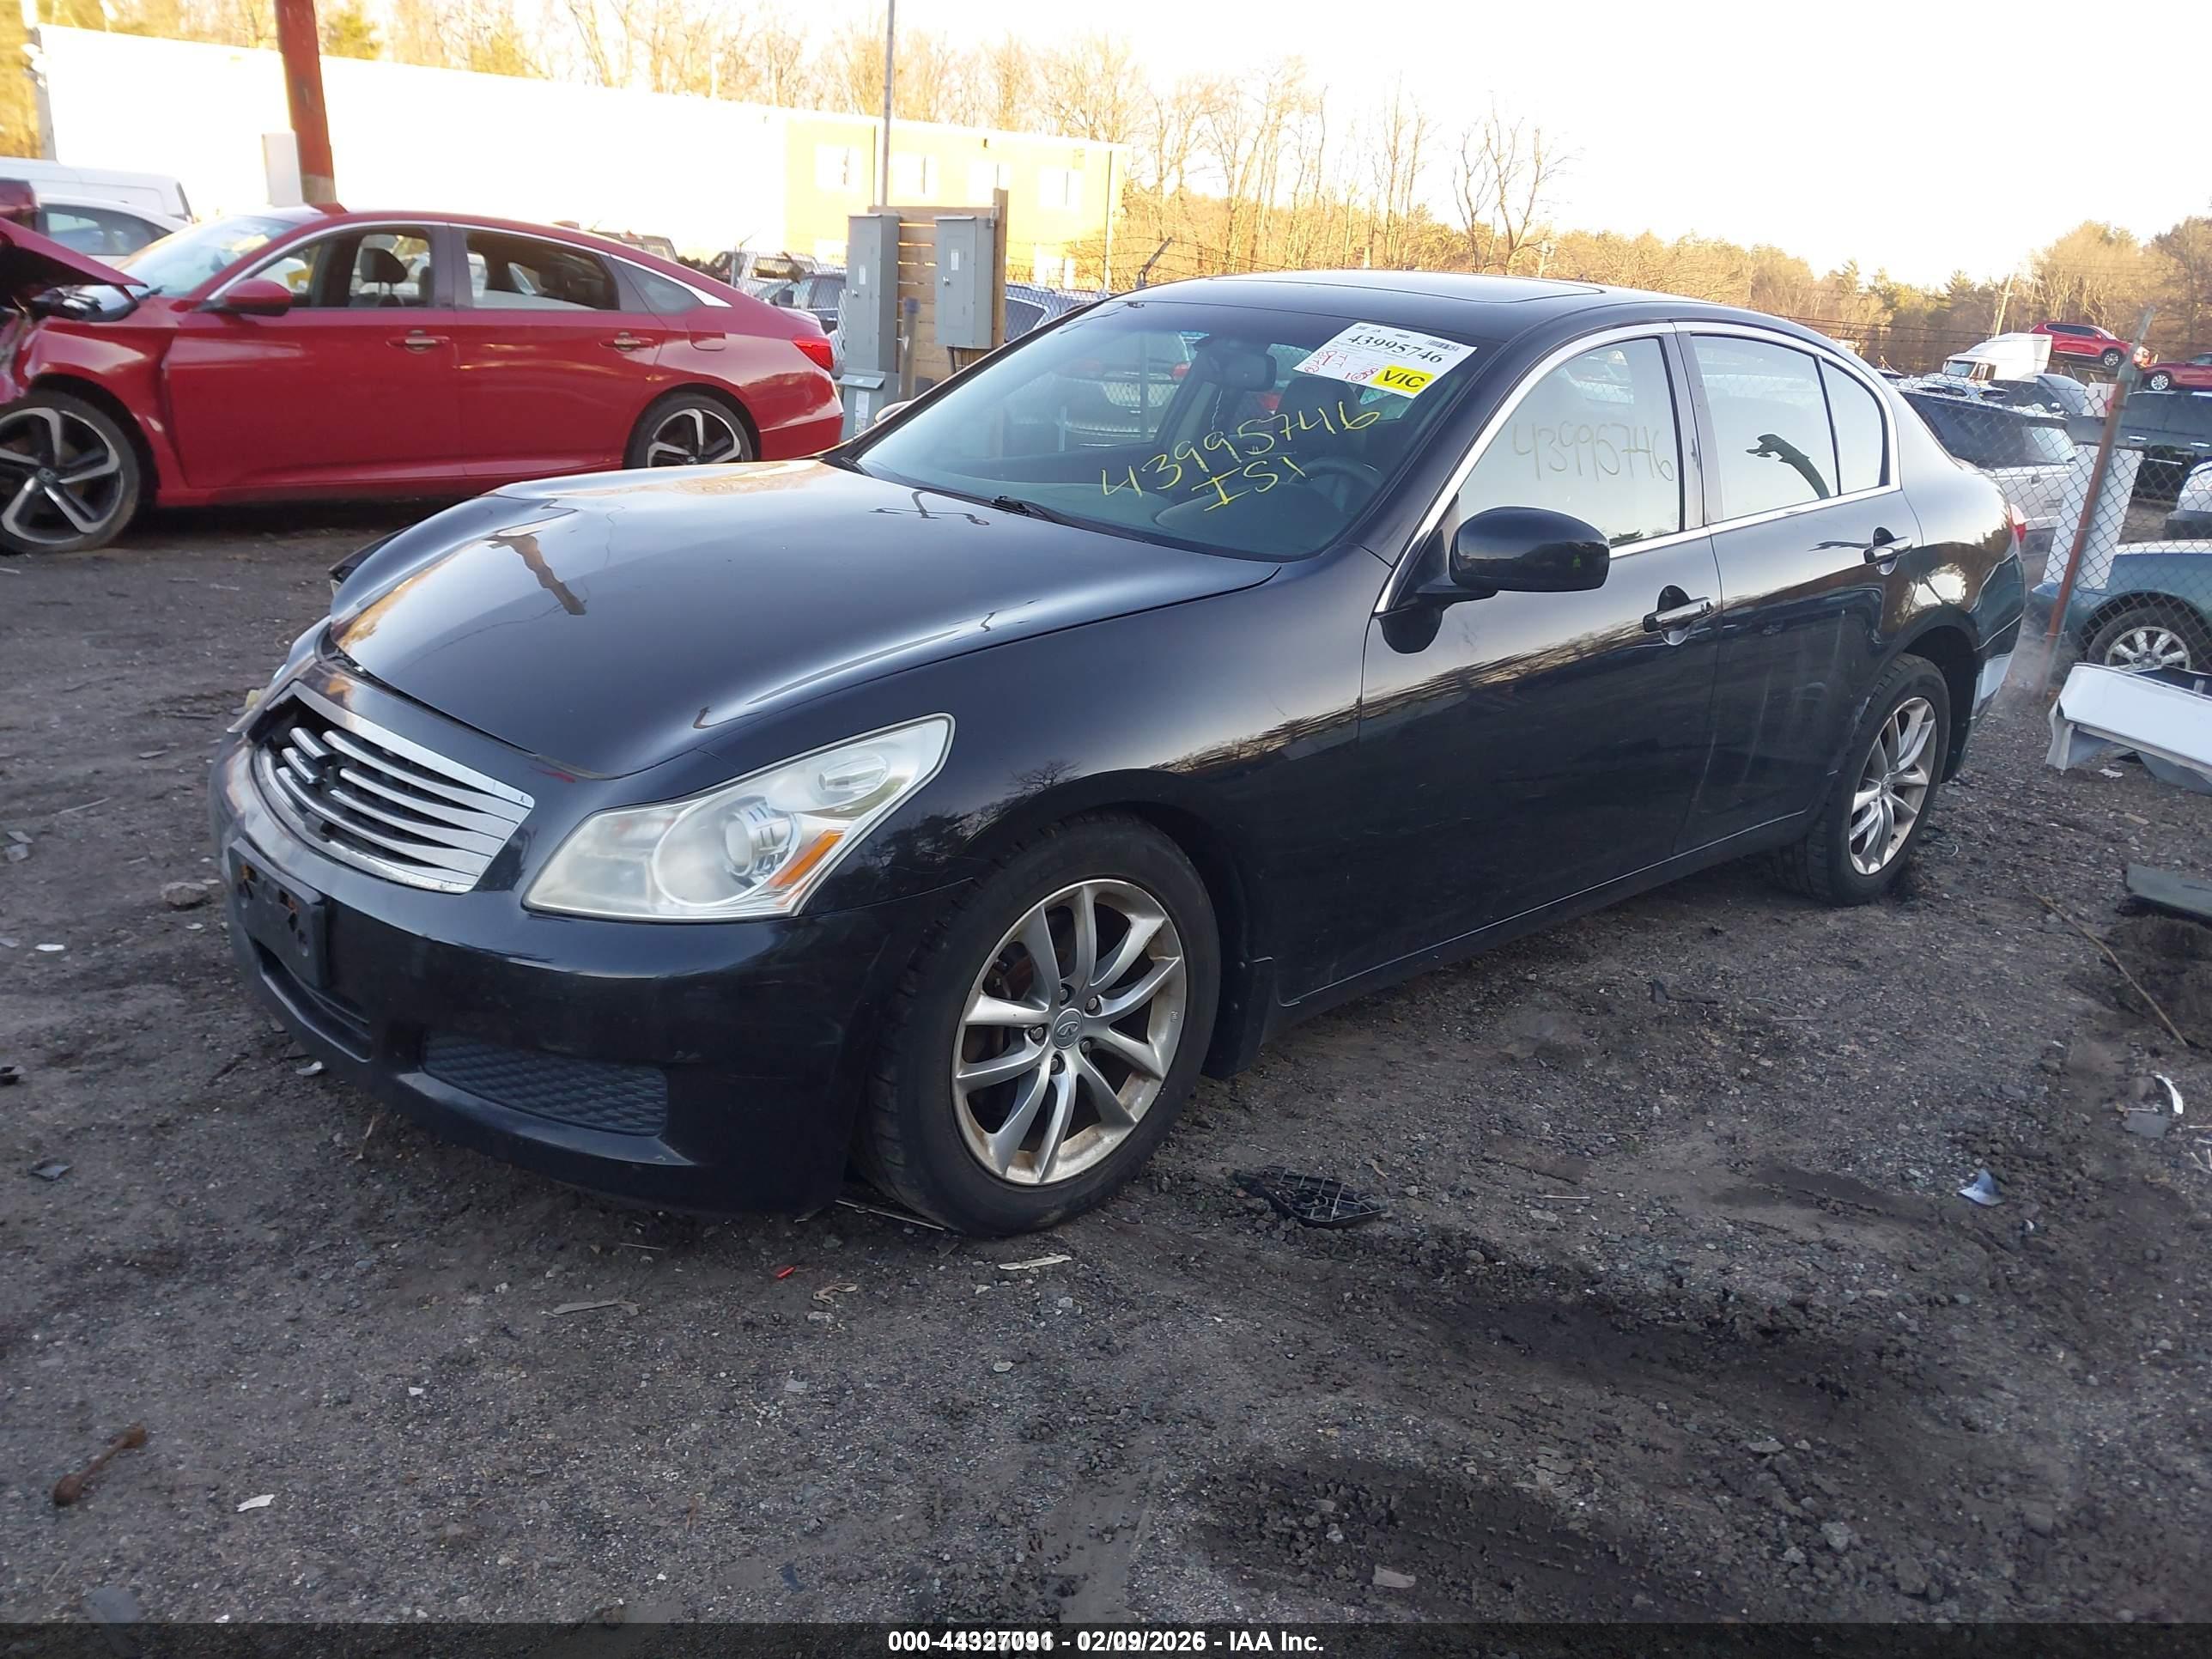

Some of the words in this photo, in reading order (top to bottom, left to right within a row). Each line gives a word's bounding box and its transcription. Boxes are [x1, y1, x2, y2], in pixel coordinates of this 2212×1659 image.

[1347, 334, 1445, 363] 43995746
[1383, 369, 1426, 389] VIC
[1102, 401, 1381, 497] 43995746
[1512, 421, 1674, 482] 43995746
